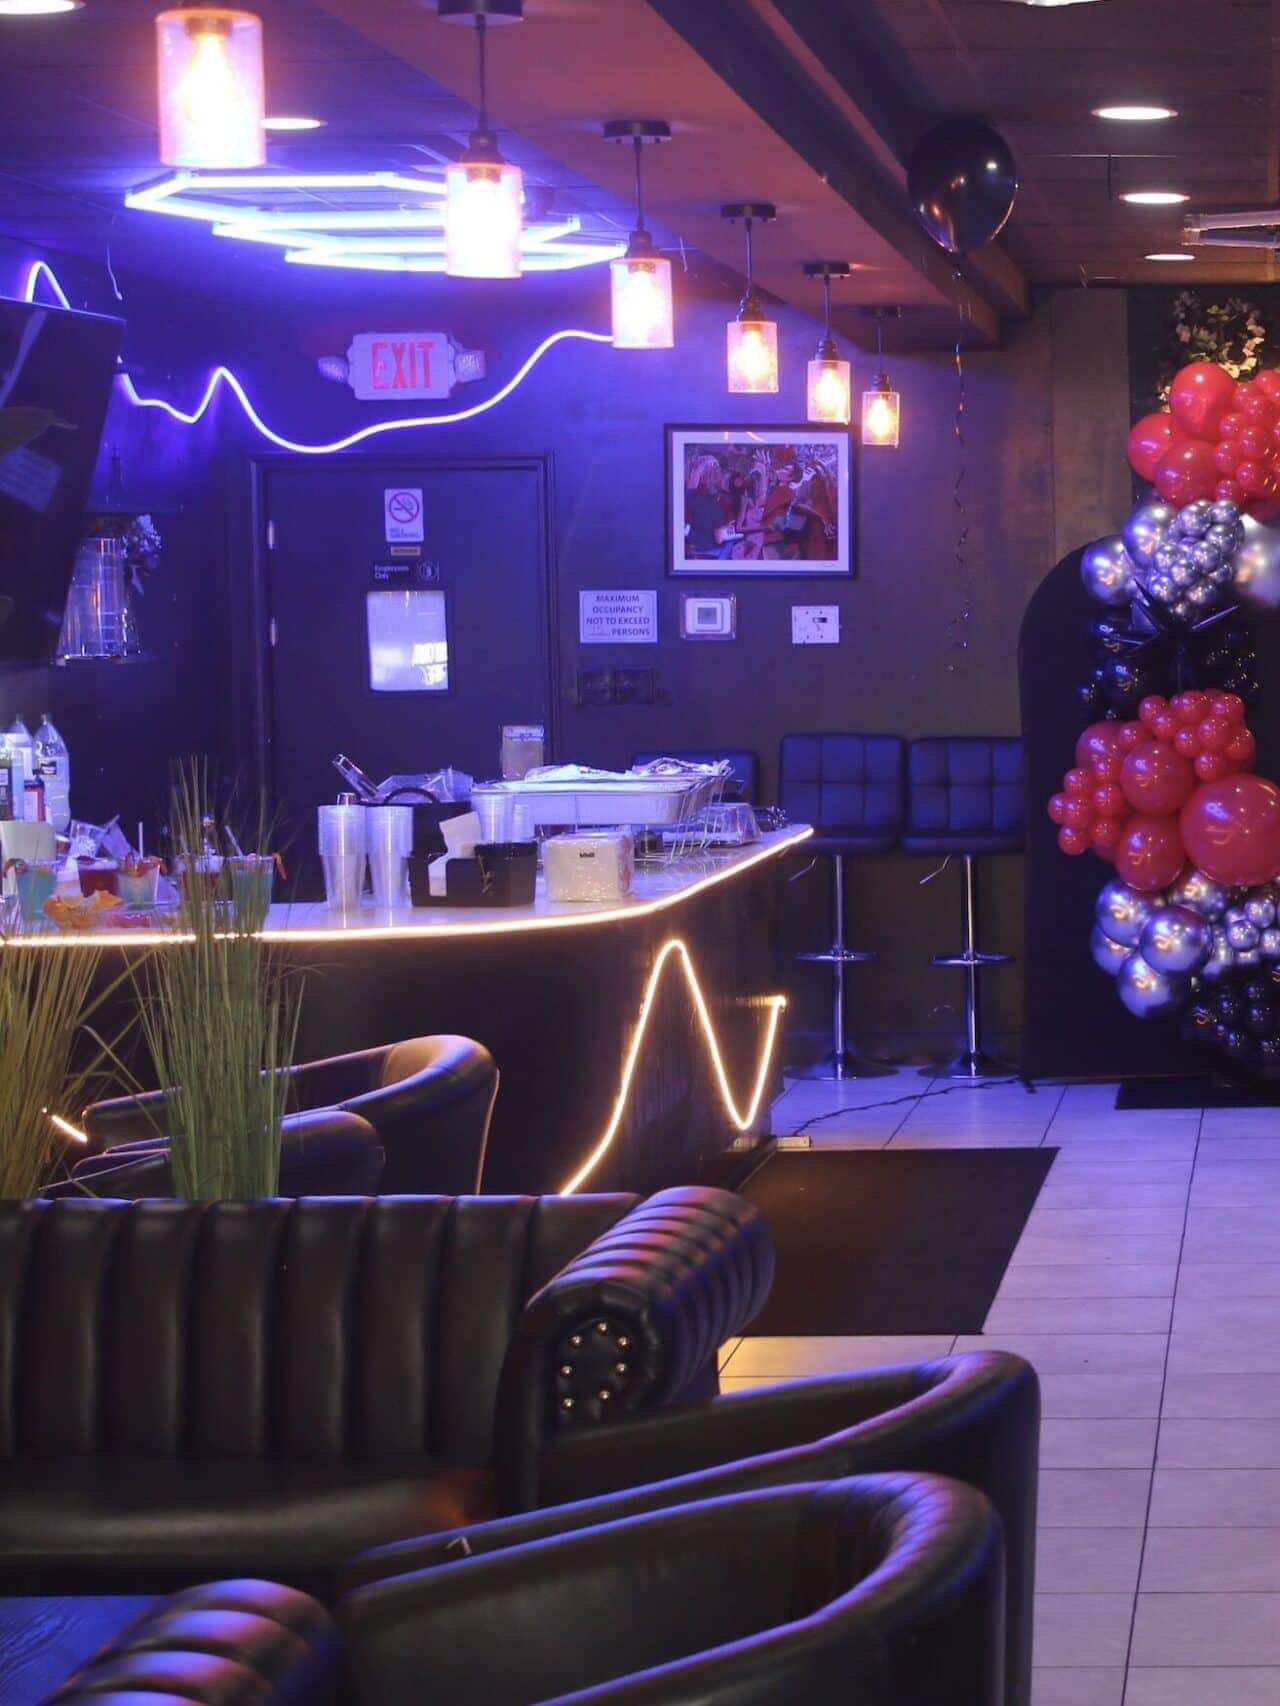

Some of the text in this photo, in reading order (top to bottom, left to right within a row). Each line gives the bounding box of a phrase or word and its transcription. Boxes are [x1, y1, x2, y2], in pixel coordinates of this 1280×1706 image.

[371, 341, 436, 390] EXIT
[592, 606, 644, 614] OCCUPANCY
[586, 617, 650, 625] NOT TO EXCEED
[611, 628, 650, 636] PERSONS
